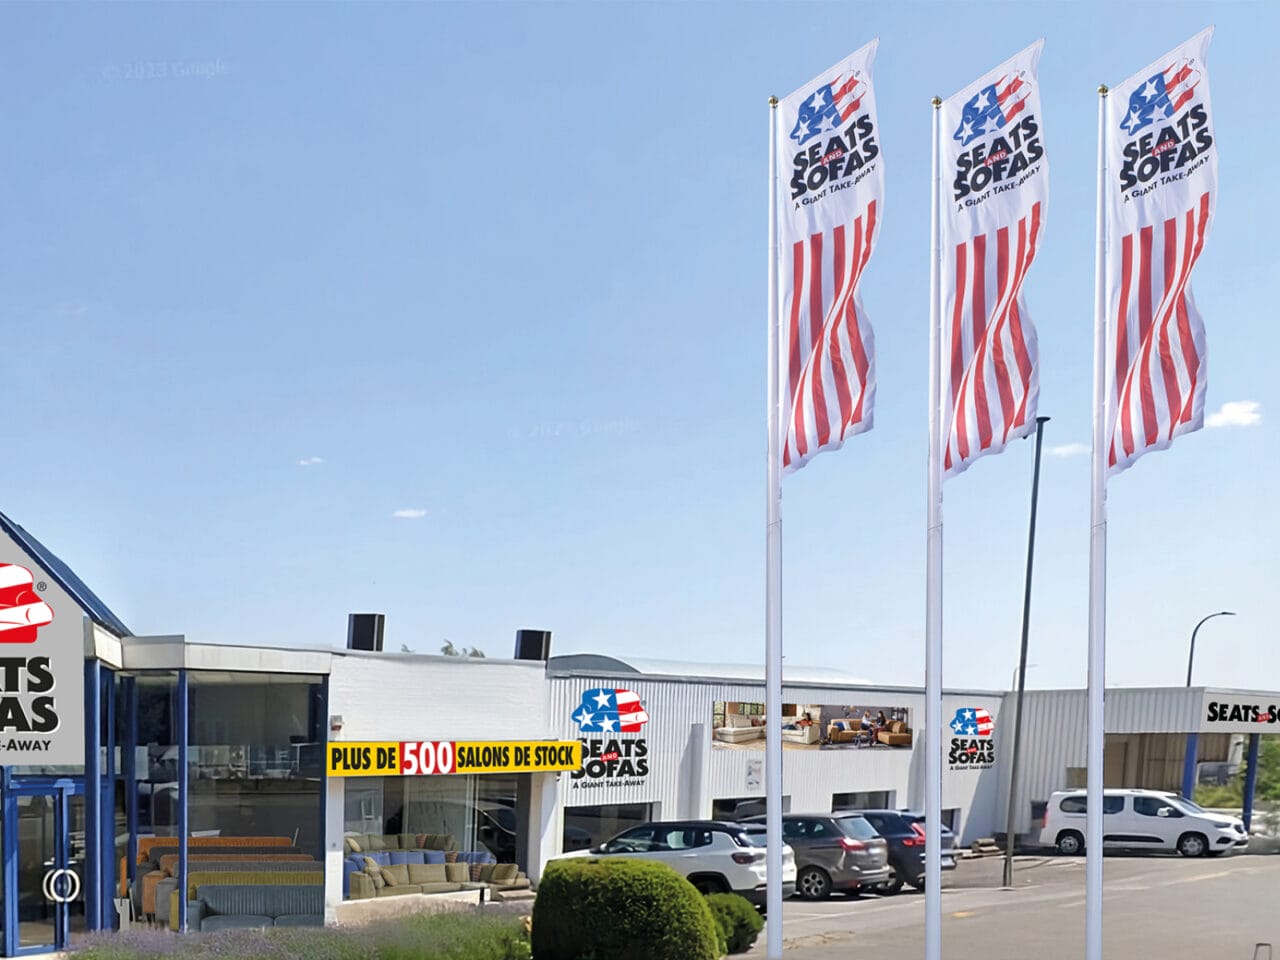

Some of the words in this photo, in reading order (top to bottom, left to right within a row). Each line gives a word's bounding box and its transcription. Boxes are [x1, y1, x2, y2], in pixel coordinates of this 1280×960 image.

[792, 113, 874, 172] SEATS
[956, 114, 1038, 172] SEATS
[1123, 103, 1208, 165] SEATS
[1154, 141, 1175, 156] AND
[790, 136, 879, 201] SOFAS
[823, 150, 842, 165] AND
[953, 137, 1044, 202] SOFAS
[985, 151, 1006, 166] AND
[1120, 127, 1213, 193] SOFAS
[1131, 180, 1157, 197] GIANT
[1160, 155, 1210, 185] TAKE-AWAY
[801, 189, 827, 206] GIANT
[829, 164, 876, 193] TAKE-AWAY
[964, 190, 990, 207] GIANT
[993, 165, 1041, 195] TAKE-AWAY
[1207, 701, 1260, 723] SEATS
[331, 747, 371, 770] PLUS
[377, 747, 396, 770] DE
[403, 742, 453, 775] 500
[457, 746, 510, 768] SALONS
[514, 746, 530, 766] DE
[534, 745, 574, 766] STOCK
[601, 752, 618, 761] AND
[949, 751, 995, 764] SOFAS
[950, 738, 994, 752] SEATS
[581, 781, 604, 789] GIANT
[606, 780, 644, 788] TAKE-AWAY
